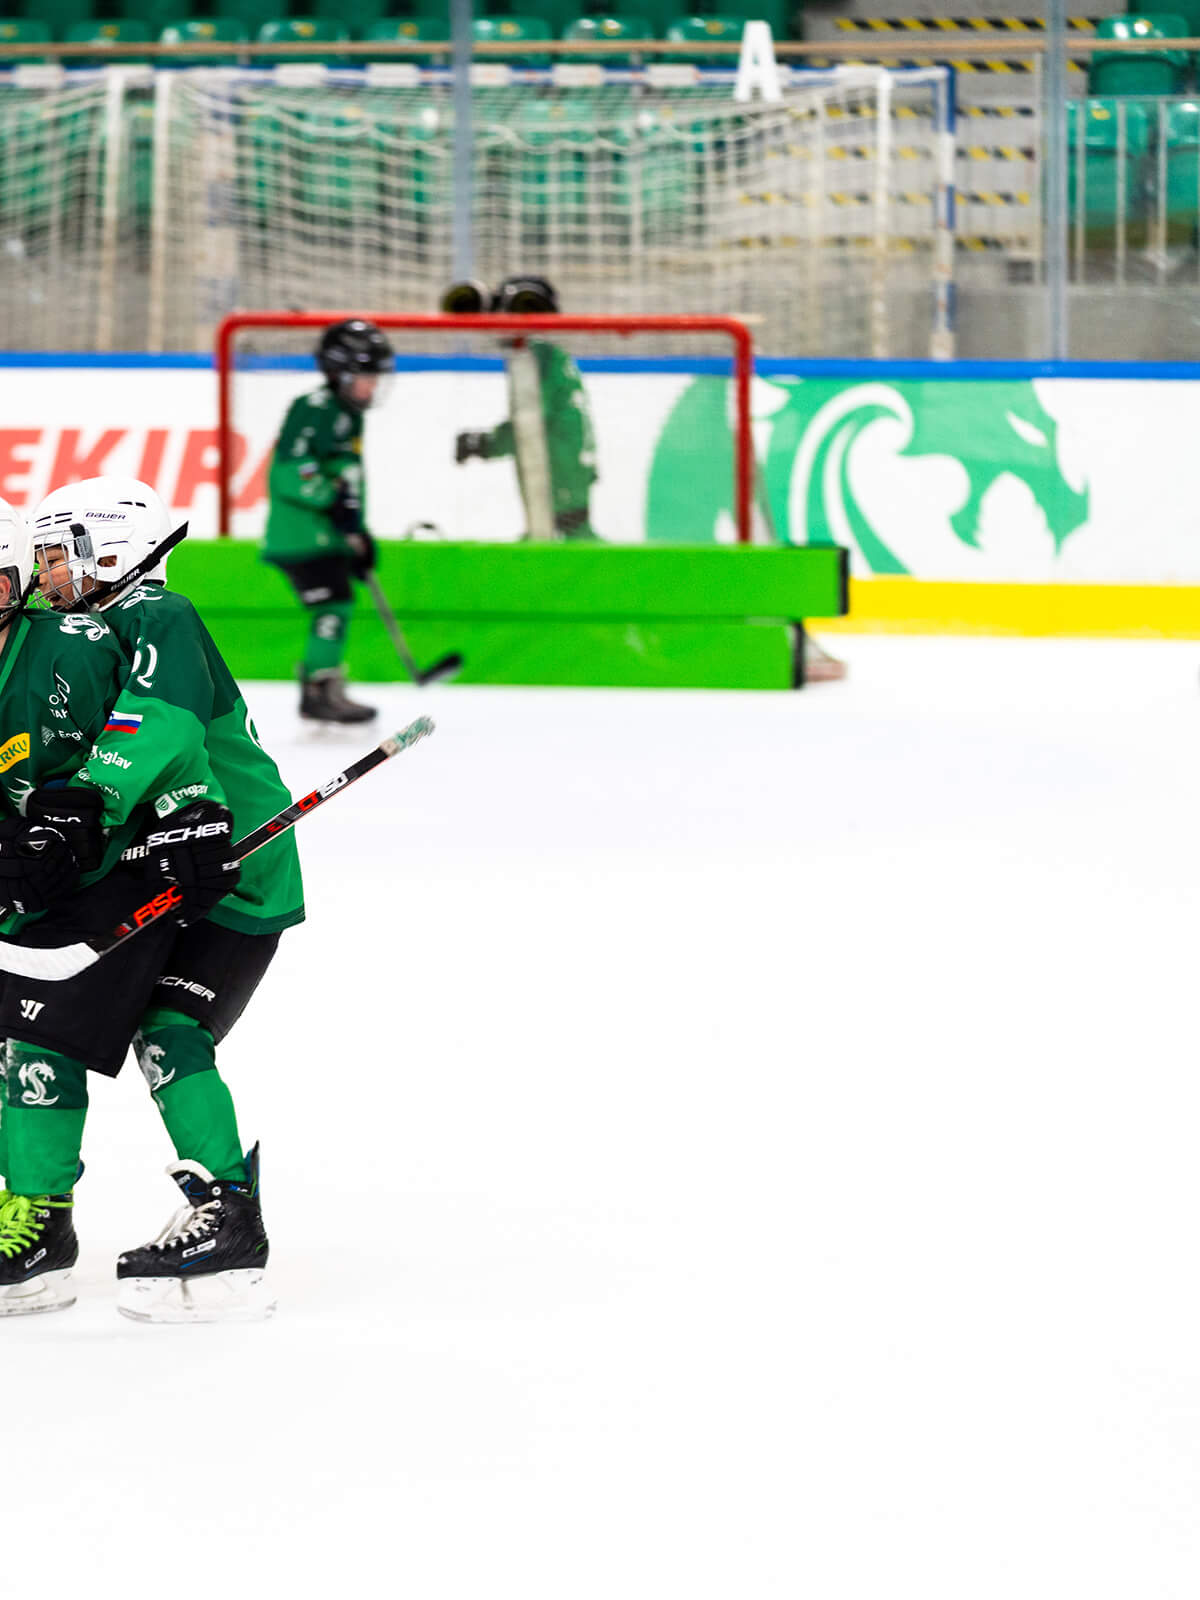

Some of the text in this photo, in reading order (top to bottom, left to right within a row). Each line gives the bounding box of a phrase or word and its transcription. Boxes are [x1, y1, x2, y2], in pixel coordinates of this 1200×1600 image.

[735, 20, 783, 102] A
[146, 821, 230, 848] SCHER
[133, 885, 183, 927] FISC
